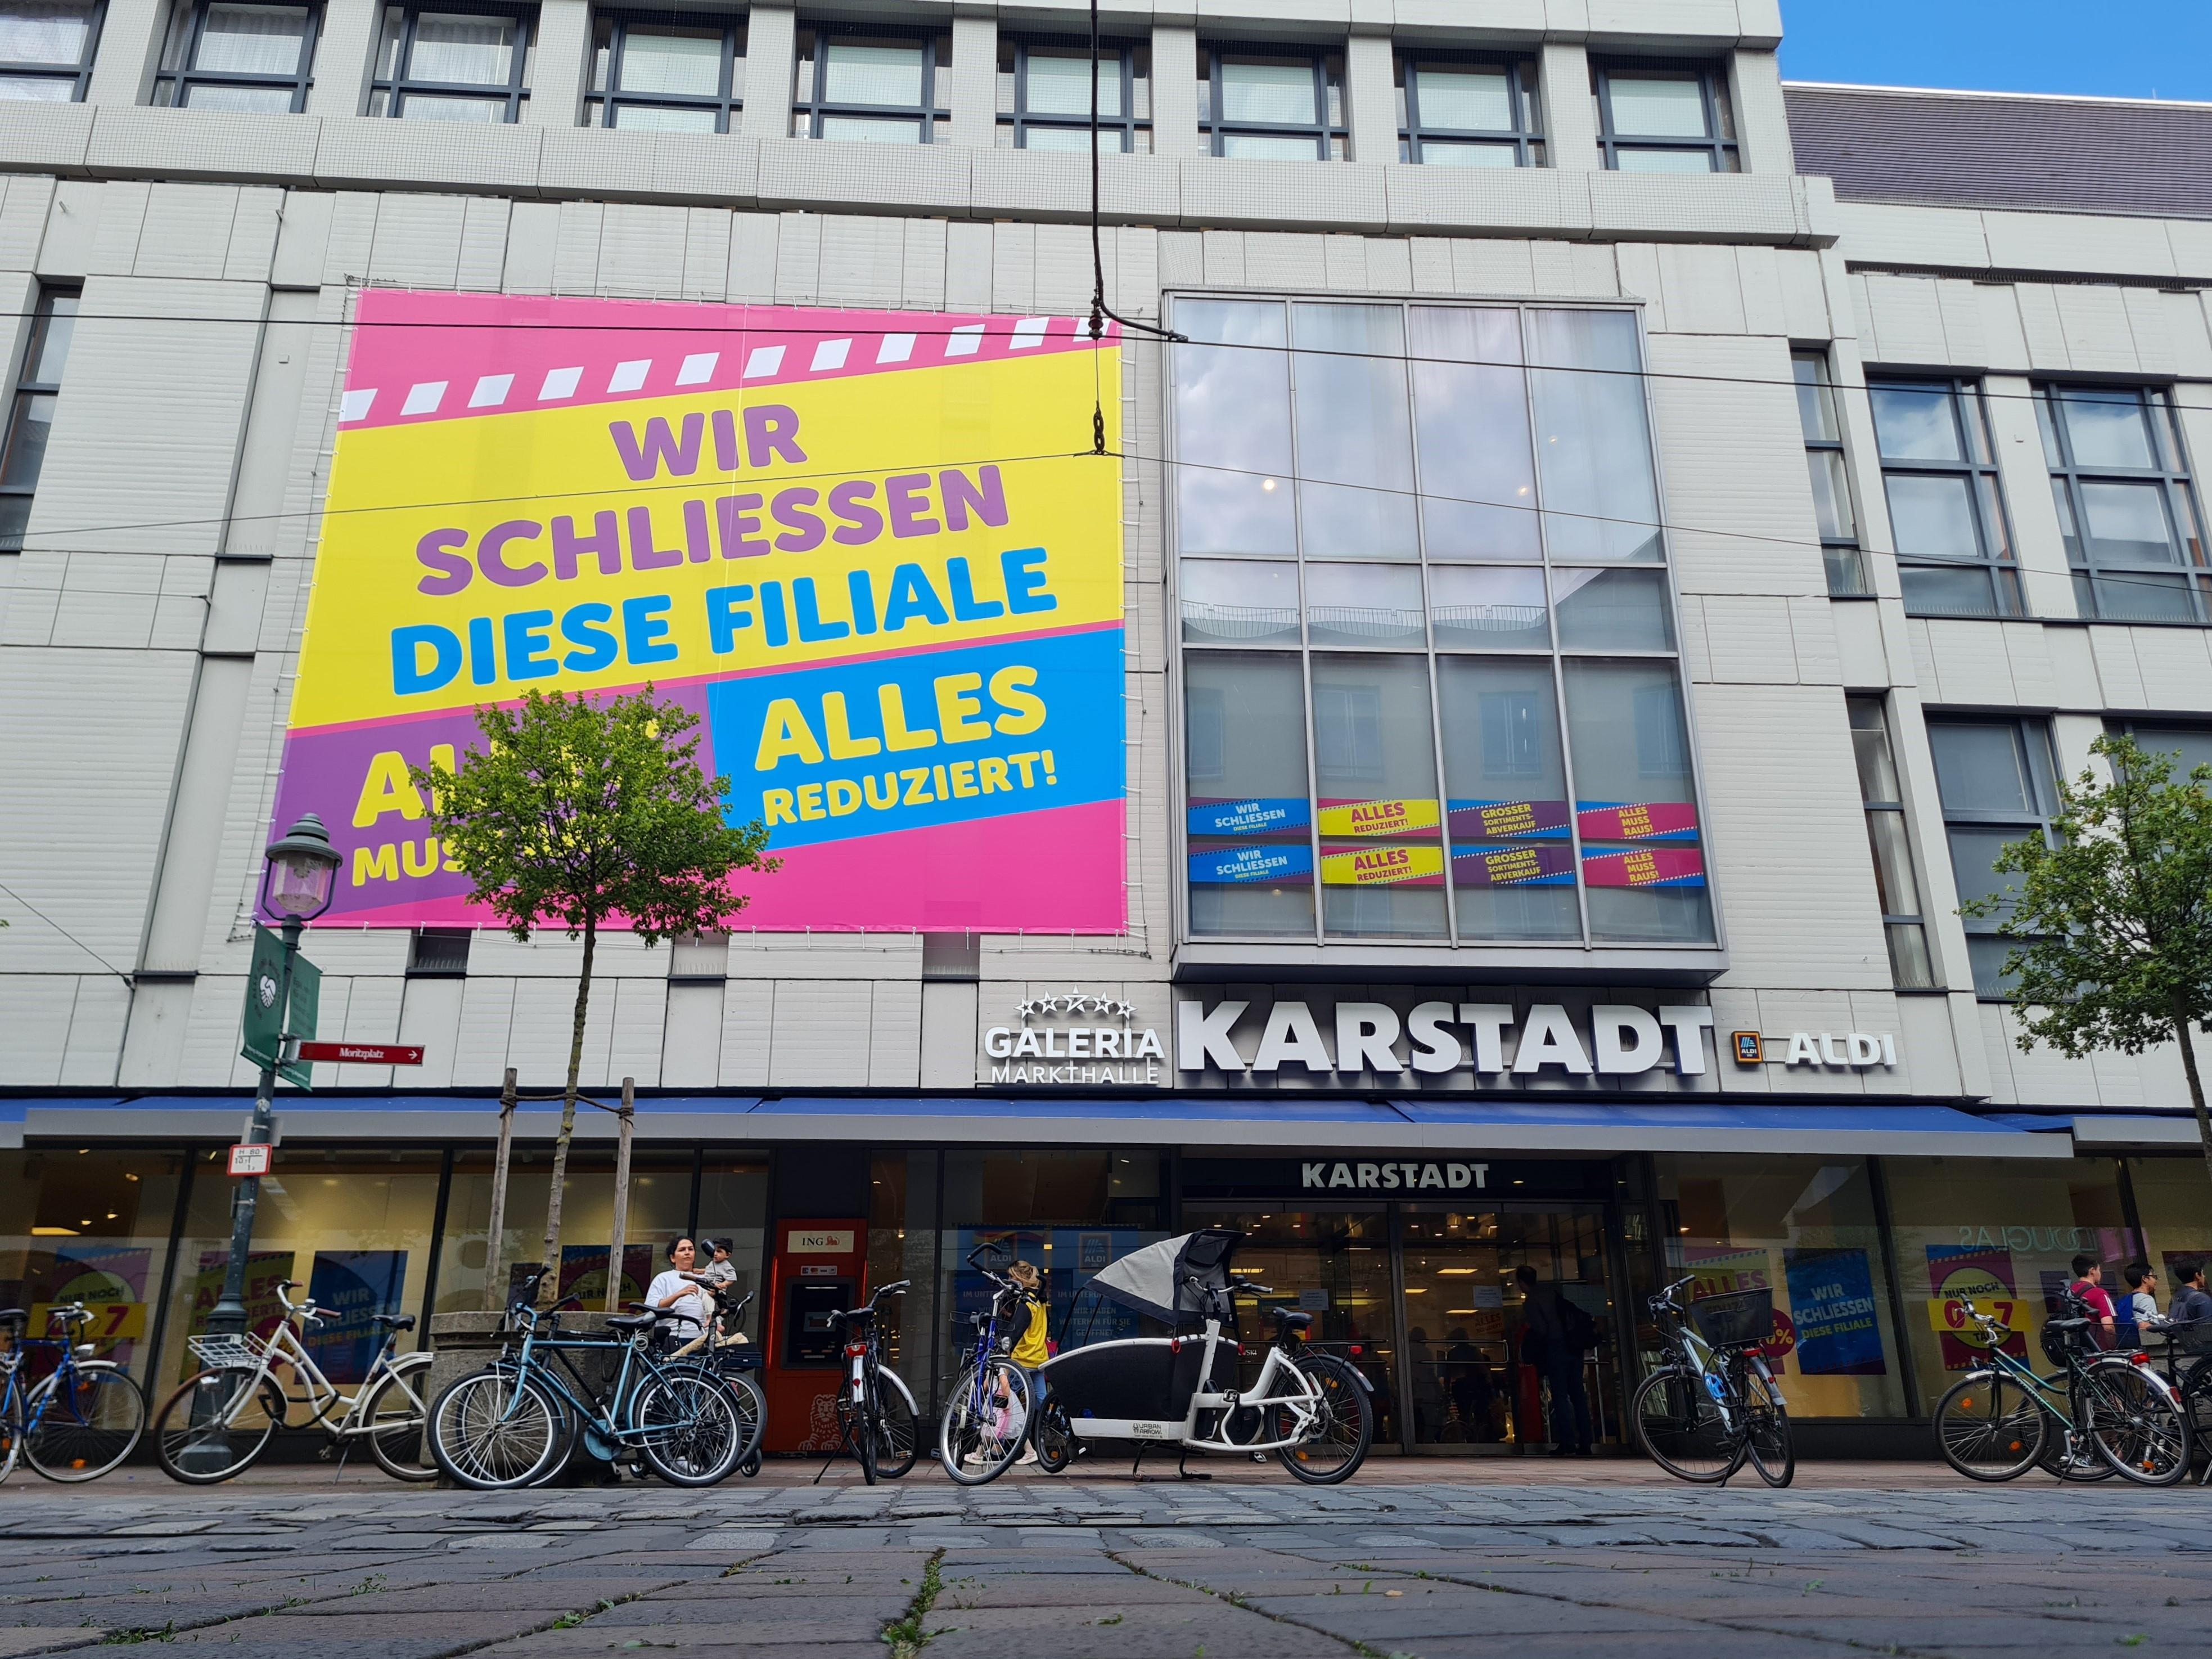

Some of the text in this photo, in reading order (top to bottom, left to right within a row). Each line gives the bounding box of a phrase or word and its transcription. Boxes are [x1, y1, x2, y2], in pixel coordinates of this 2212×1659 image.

[609, 404, 808, 481] WIR
[416, 465, 1009, 596] SCHLIESSEN
[391, 547, 1057, 695] DIESE FILIALE
[755, 665, 1047, 771] ALLES
[762, 749, 1057, 826] REDUZIERT!
[1235, 802, 1260, 813] WIR
[1351, 802, 1405, 822] ALLES
[1481, 803, 1532, 818] GROSSER
[1618, 807, 1647, 818] ALLES
[1215, 809, 1286, 828] SCHLIESSEN
[1354, 818, 1408, 833] REDUZIERT!
[1483, 814, 1534, 826] SORTIMENTS-
[1486, 820, 1536, 835] ABVERKAUF
[1621, 816, 1650, 826] MUSS
[1623, 824, 1654, 835] RAUS!
[352, 837, 503, 887] MUS
[1237, 849, 1262, 861] WIR
[1354, 849, 1409, 871] ALLES
[1485, 849, 1537, 865] GROSSER
[1624, 852, 1654, 864] ALLES
[1216, 856, 1288, 875] SCHLIESSEN
[1357, 866, 1412, 882] REDUZIERT!
[1488, 861, 1538, 873] SORTIMENTS-
[1490, 866, 1541, 882] ABVERKAUF
[1627, 862, 1655, 873] MUSS
[1629, 870, 1659, 882] RAUS!
[984, 1027, 1166, 1059] GALERIA
[1178, 1000, 1714, 1076] KARSTADT
[339, 1047, 384, 1060] Moritzplatz
[1785, 1031, 1898, 1067] ALDI
[991, 1065, 1159, 1085] MARKTHALLE
[1301, 1162, 1489, 1188] KARSTADT
[196, 1274, 283, 1309] AES
[1693, 1269, 1767, 1300] ALLES
[1810, 1283, 1845, 1301] WIR
[1944, 1282, 1999, 1298] NUR NOCH
[333, 1287, 369, 1306] WIR
[105, 1306, 129, 1335] 7
[1794, 1297, 1875, 1325] SCHLIESSEN
[1801, 1318, 1873, 1339] DIESE FILIALE
